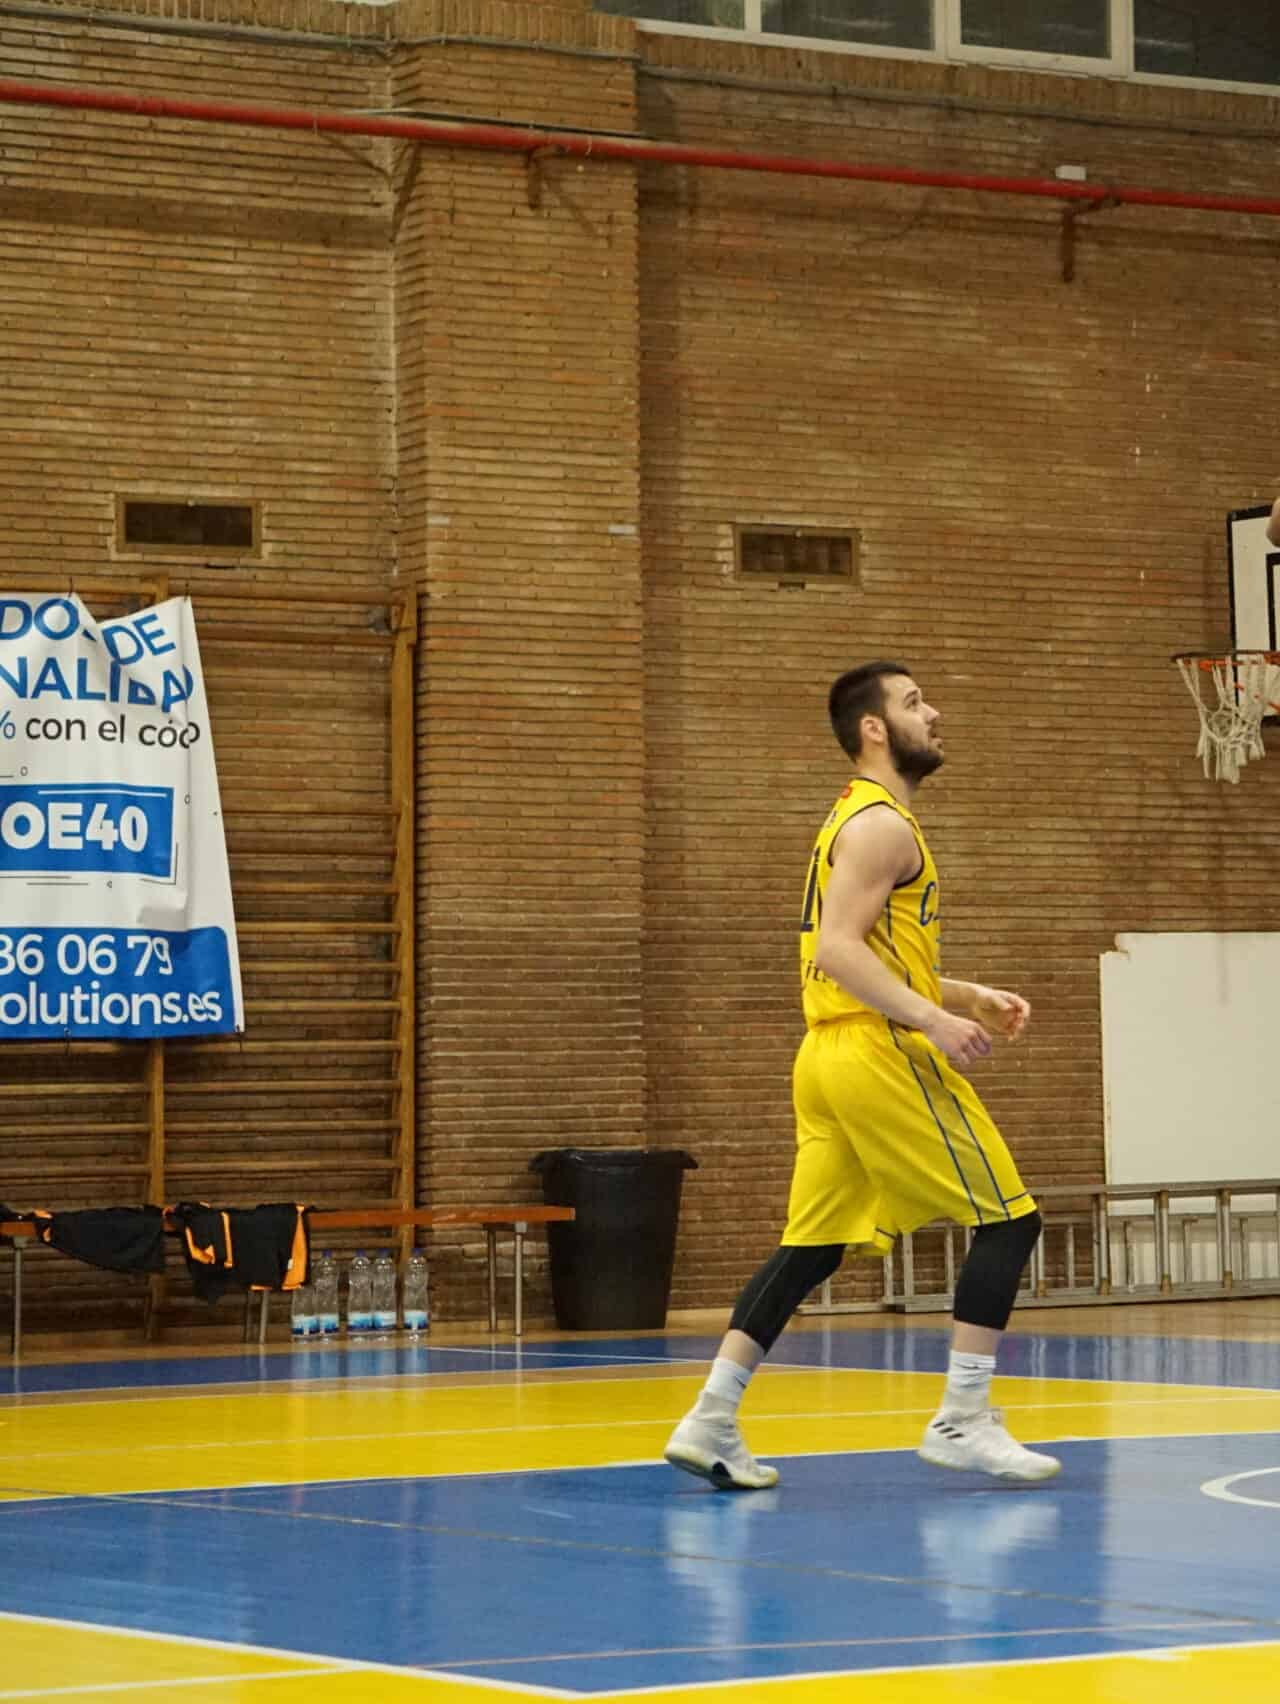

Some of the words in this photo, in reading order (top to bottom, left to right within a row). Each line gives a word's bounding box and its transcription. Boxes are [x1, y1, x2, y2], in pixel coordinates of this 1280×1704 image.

[101, 613, 177, 666] DE
[25, 717, 87, 741] con
[97, 713, 126, 743] el
[57, 933, 118, 976] 06
